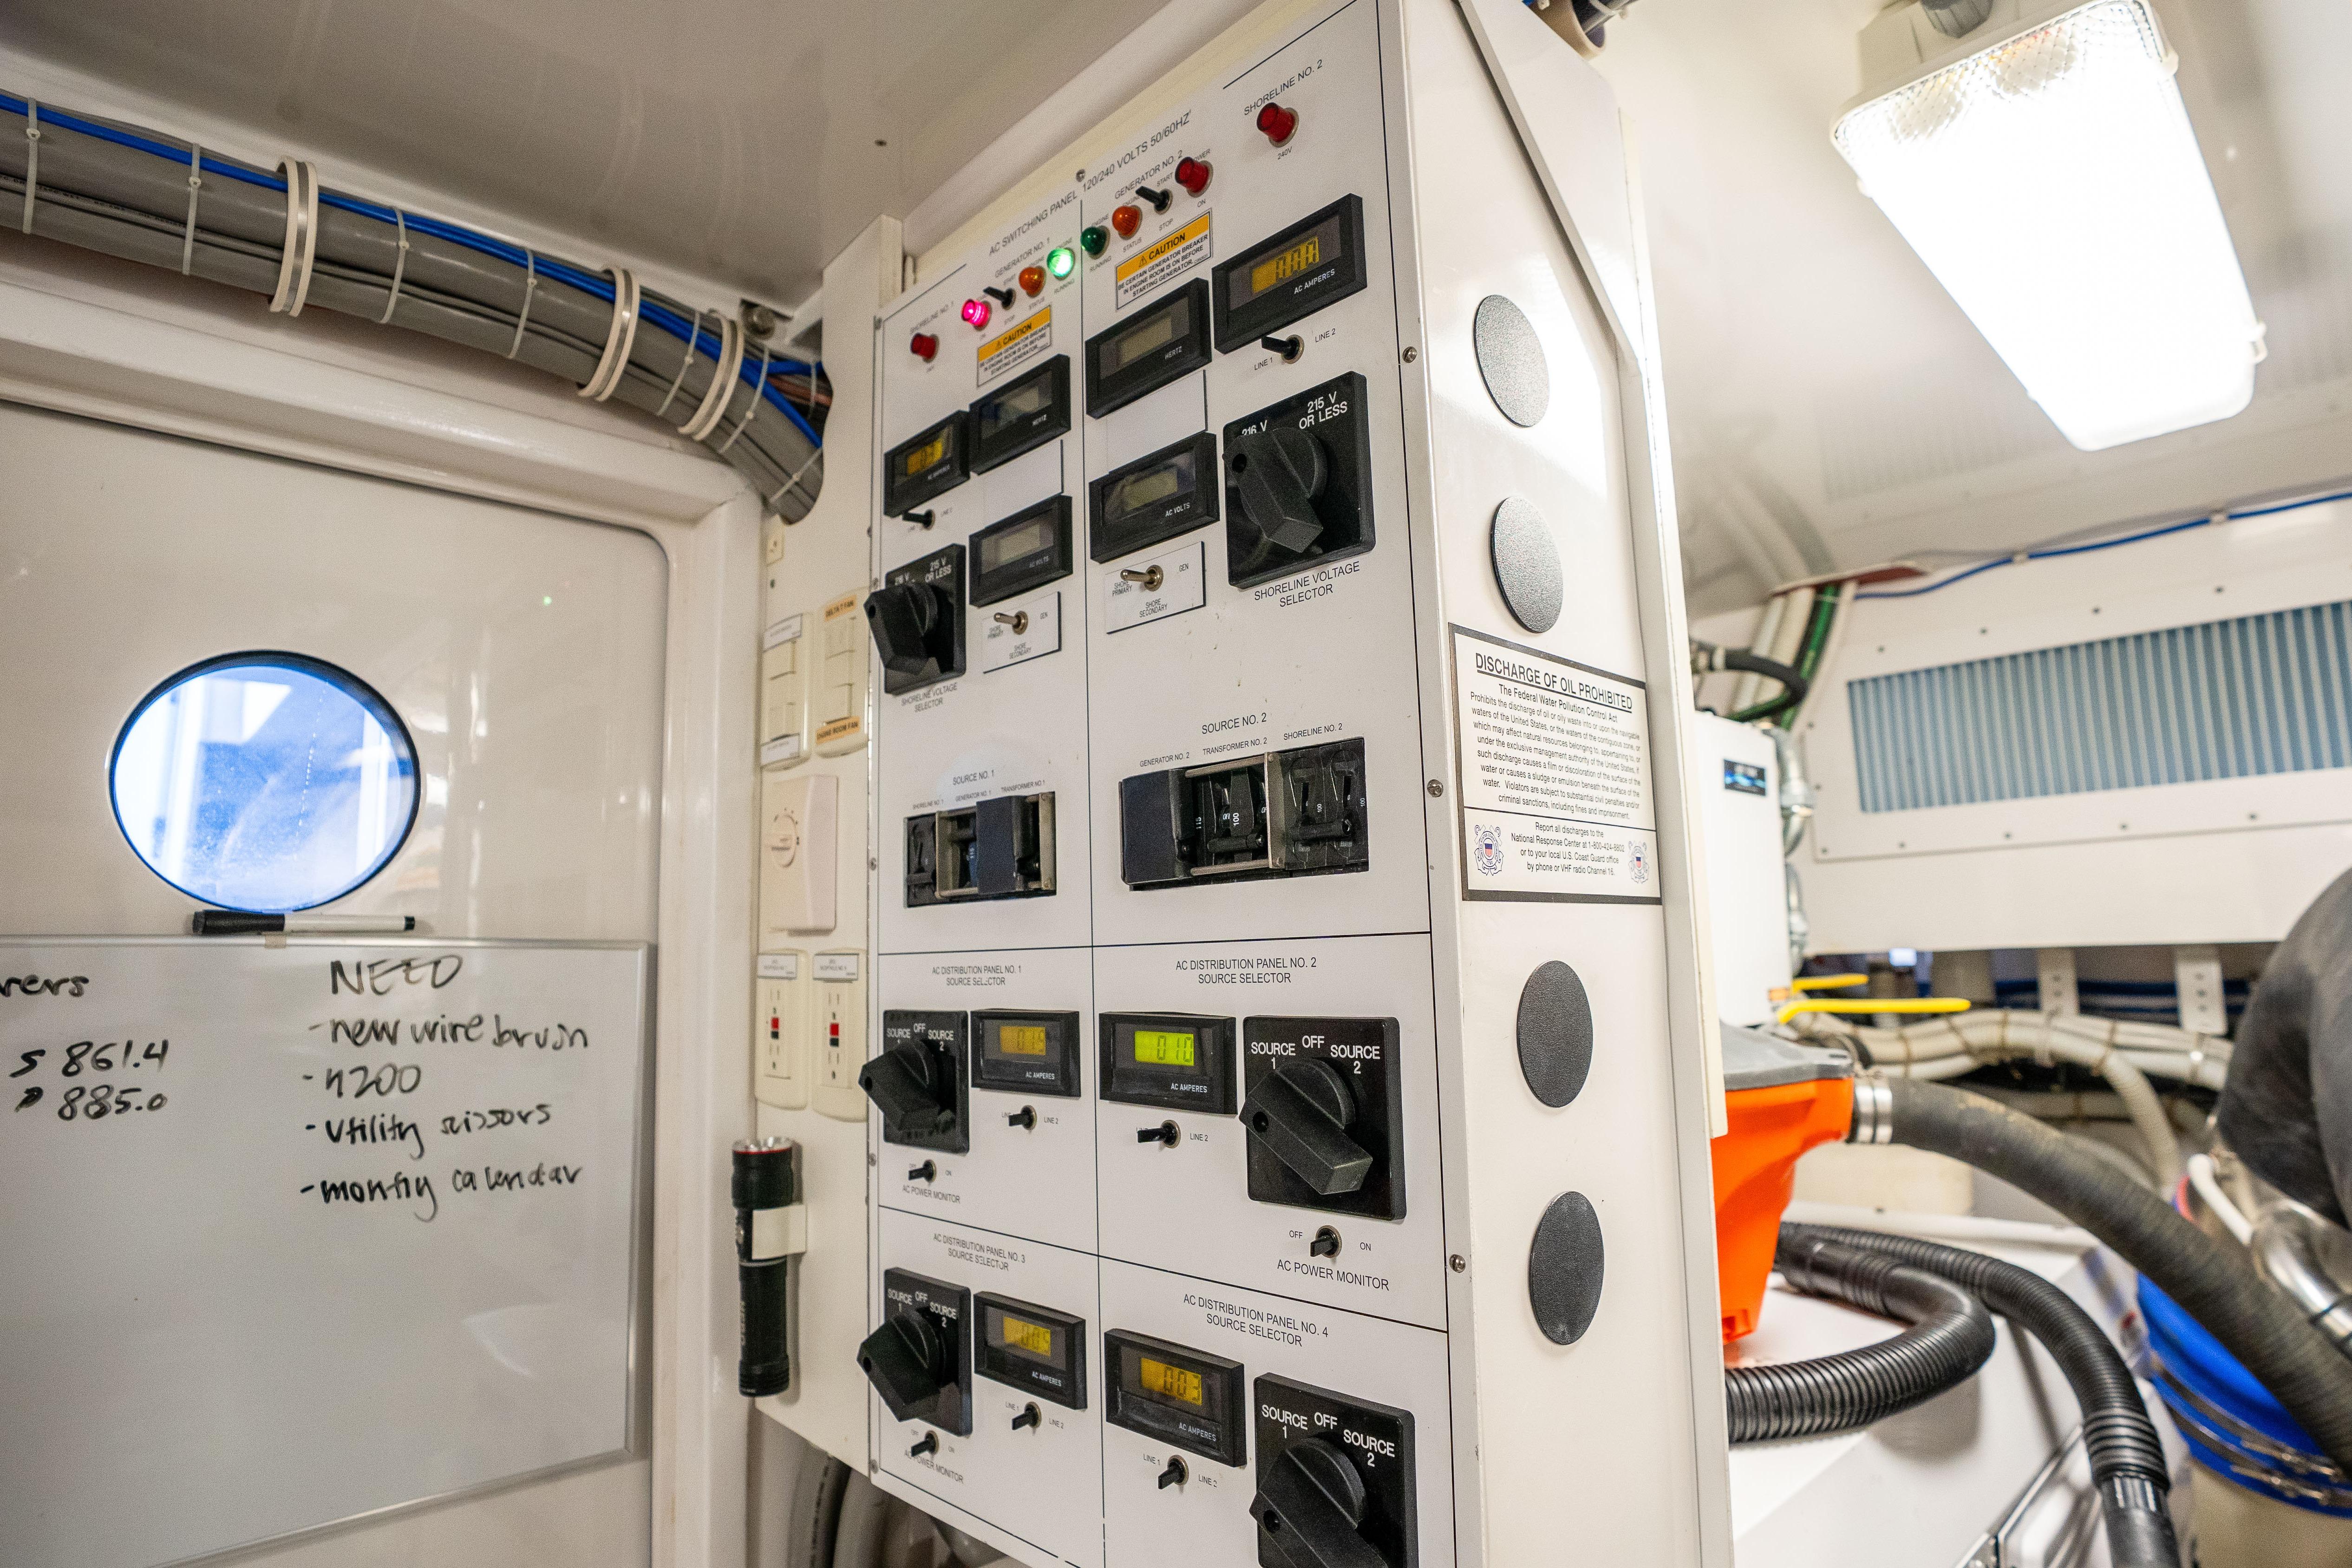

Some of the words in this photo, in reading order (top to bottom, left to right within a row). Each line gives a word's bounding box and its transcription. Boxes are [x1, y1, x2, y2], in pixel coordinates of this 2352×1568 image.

[1244, 77, 1295, 115] SHORELINE
[1298, 66, 1314, 81] NO.
[1317, 59, 1322, 69] 2
[1277, 147, 1292, 159] 240V
[1115, 164, 1160, 199] GENERATOR
[1162, 155, 1175, 171] NO.
[1178, 150, 1183, 158] 2
[1156, 172, 1173, 187] START
[989, 242, 1000, 255] AC
[1002, 210, 1048, 247] SWITCHING
[1050, 190, 1078, 215] PANEL
[1083, 163, 1115, 192] 120/240
[1117, 141, 1148, 169] VOLTS
[1197, 199, 1206, 207] ON
[1159, 218, 1173, 231] STOP
[1123, 237, 1142, 253] STATUS
[1148, 233, 1185, 260] CAUTION
[1125, 270, 1147, 286] CERTAIN
[1148, 251, 1181, 273] GENERATOR
[1182, 235, 1208, 255] BREAKER
[1130, 275, 1148, 292] ENGINE
[1149, 266, 1165, 281] ROOM
[1166, 263, 1170, 272] IS
[1171, 258, 1180, 269] ON
[1181, 245, 1203, 264] BEFORE
[1132, 279, 1158, 297] STARTING
[1294, 286, 1303, 294] AC
[1304, 269, 1335, 288] AMPERES
[1315, 331, 1330, 343] LINE
[1165, 346, 1182, 359] HERTZ
[1307, 397, 1324, 413] 215
[1329, 392, 1337, 404] V
[1299, 415, 1315, 430] OR
[1319, 401, 1348, 423] LESS
[1260, 420, 1267, 432] V
[1179, 563, 1189, 572] GEN
[1254, 577, 1310, 601] SHORELINE
[1312, 561, 1360, 583] VOLTAGE
[1145, 598, 1161, 609] SHORE
[1280, 584, 1333, 608] SELECTOR
[1139, 604, 1168, 618] SECONDARY
[1476, 653, 1541, 685] DISCHARGE
[1544, 673, 1557, 688] OF
[1561, 677, 1576, 694] OIL
[1579, 683, 1632, 709] PROHIBITED
[1499, 684, 1512, 696] The
[1514, 687, 1538, 703] Federal
[1539, 694, 1557, 707] Water
[1559, 699, 1585, 714] Pollution
[1586, 707, 1607, 720] Control
[1609, 713, 1618, 723] Act
[1202, 717, 1240, 735] SOURCE
[1242, 715, 1259, 727] NO.
[1261, 712, 1267, 723] 2
[1283, 726, 1322, 741] SHORELINE
[1324, 725, 1336, 734] NO.
[1338, 723, 1343, 732] 2
[1202, 741, 1249, 756] TRANSFORMER
[1250, 739, 1261, 748] NO.
[1139, 755, 1174, 768] GENERATOR
[1175, 753, 1185, 761] NO.
[1535, 822, 1553, 832] Report
[1562, 826, 1589, 838] discharges
[1511, 833, 1535, 843] National
[1536, 836, 1562, 846] Response
[1564, 838, 1581, 848] Center
[1535, 850, 1547, 859] your
[1575, 852, 1589, 862] Coast
[1590, 854, 1605, 862] Guard
[1606, 855, 1619, 863] office
[1527, 861, 1534, 872] by
[1535, 863, 1553, 872] phone
[1561, 864, 1572, 872] VHF
[1573, 865, 1586, 874] radio
[1587, 866, 1607, 875] Channel
[941, 966, 982, 975] DISTRIBUTION
[983, 965, 1004, 974] PANEL
[1005, 965, 1016, 974] NO.
[1018, 965, 1021, 973] 1
[1176, 960, 1188, 970] AC
[1190, 959, 1254, 970] DISTRIBUTION
[1256, 958, 1288, 968] PANEL
[1290, 958, 1308, 968] NO.
[1310, 957, 1317, 967] 2
[330, 954, 463, 995] NEED
[946, 977, 971, 986] SOURCE
[972, 976, 1006, 986] SELECTOR
[1198, 973, 1237, 984] SOURCE
[1240, 973, 1291, 984] SELECTOR
[410, 1013, 483, 1044] wire
[913, 1023, 926, 1034] OFF
[928, 1029, 954, 1041] SOURCE
[939, 1041, 944, 1051] 2
[1251, 1042, 1296, 1056] SOURCE
[1302, 1035, 1325, 1049] OFF
[61, 1039, 169, 1077] 861.4
[1330, 1044, 1380, 1060] SOURCE
[1271, 1057, 1276, 1070] 1
[1353, 1061, 1361, 1074] 2
[1180, 1084, 1208, 1093] AMPERES
[57, 1084, 168, 1120] 885.0
[1289, 1230, 1303, 1240] OFF
[1360, 1242, 1372, 1252] ON
[1277, 1259, 1291, 1271] AC
[1294, 1262, 1334, 1281] POWER
[1337, 1271, 1390, 1291] MONITOR
[1183, 1294, 1196, 1306] AC
[1198, 1296, 1264, 1323] DISTRIBUTION
[1267, 1313, 1299, 1331] PANEL
[1301, 1321, 1320, 1336] NO.
[1322, 1326, 1329, 1338] 4
[1206, 1313, 1247, 1333] SOURCE
[1249, 1324, 1303, 1347] SELECTOR
[1261, 1404, 1308, 1431] SOURCE
[1314, 1412, 1338, 1430] OFF
[1282, 1426, 1287, 1439] 1
[1343, 1429, 1395, 1457] SOURCE
[1367, 1452, 1375, 1468] 2
